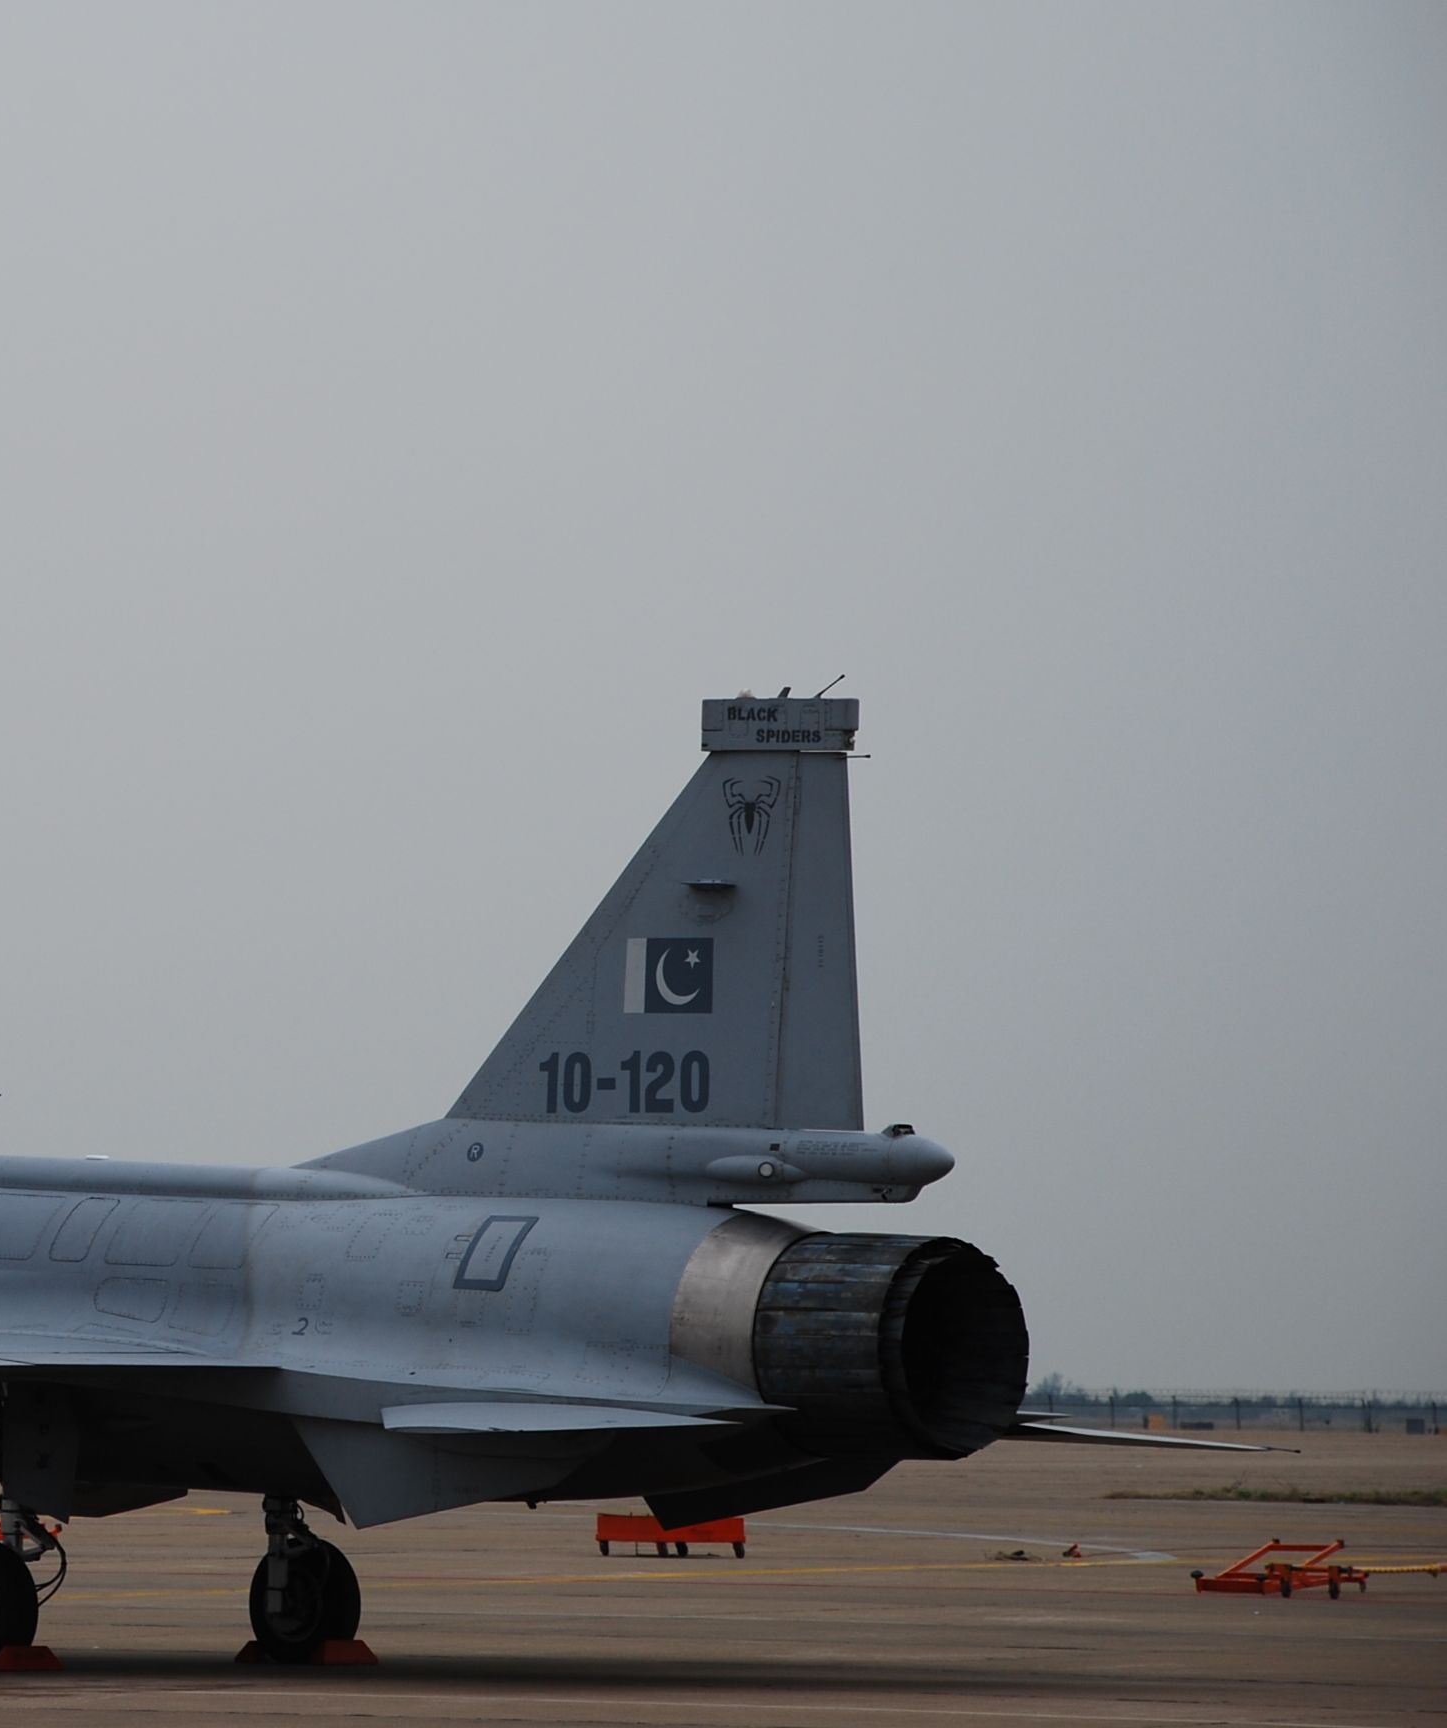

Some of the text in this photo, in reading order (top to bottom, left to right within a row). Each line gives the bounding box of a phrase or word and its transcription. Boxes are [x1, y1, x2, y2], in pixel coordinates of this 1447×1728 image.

[727, 706, 778, 722] BLACK
[756, 728, 822, 743] SPIDERS
[539, 1050, 711, 1114] 10-120
[290, 1316, 309, 1336] 2
